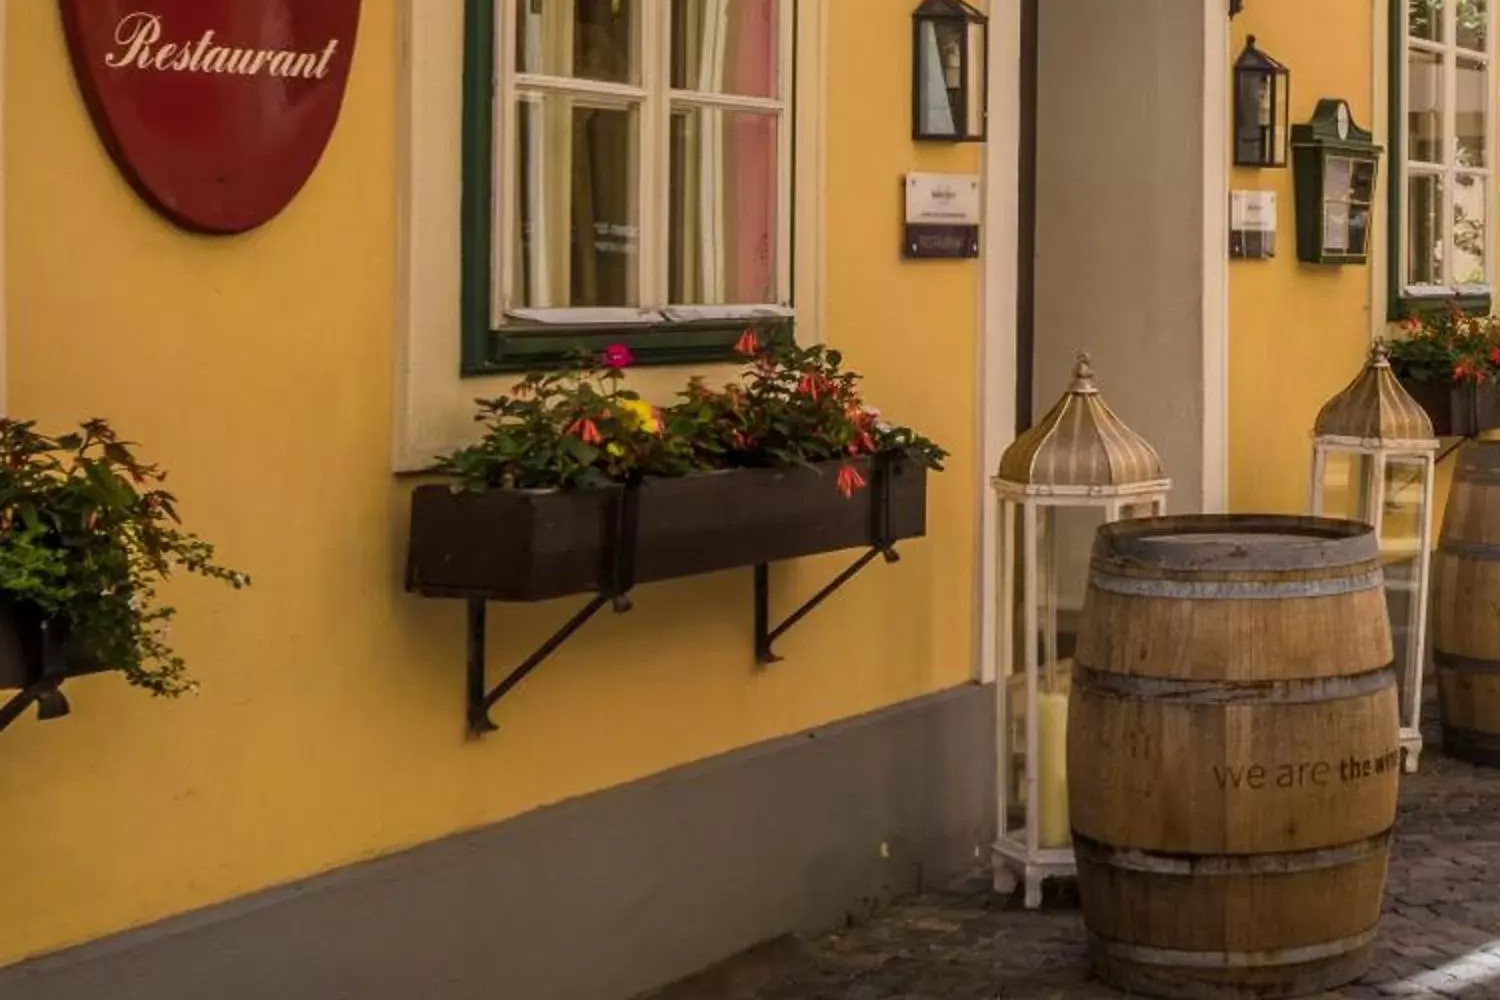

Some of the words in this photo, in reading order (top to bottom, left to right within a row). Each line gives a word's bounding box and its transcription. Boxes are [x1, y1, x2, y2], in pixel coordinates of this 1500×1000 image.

[105, 11, 338, 80] Restaurant
[1213, 762, 1266, 790] we
[1276, 760, 1332, 789] are
[1339, 755, 1371, 782] the
